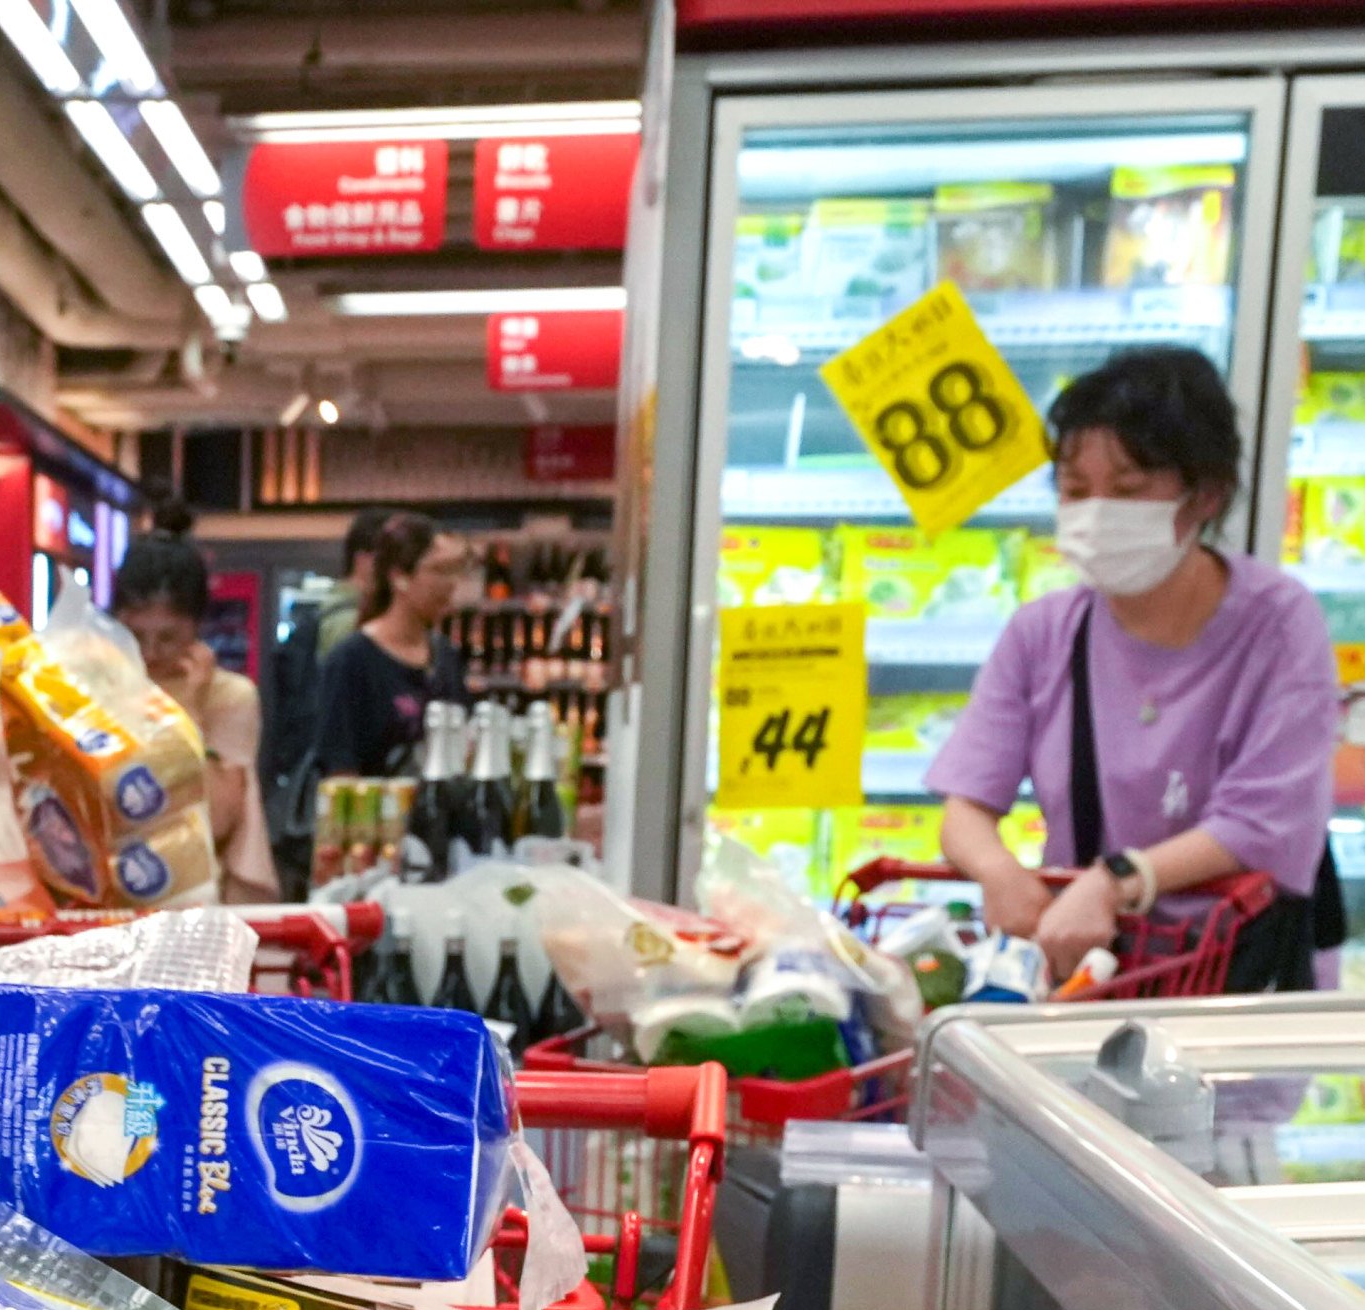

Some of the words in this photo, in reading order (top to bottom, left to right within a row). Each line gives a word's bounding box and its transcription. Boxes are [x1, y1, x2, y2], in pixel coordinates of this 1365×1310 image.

[875, 360, 1009, 490] 88
[199, 1056, 231, 1156] CLASSIC
[278, 1105, 307, 1176] Vinda
[197, 1160, 232, 1215] Blue
